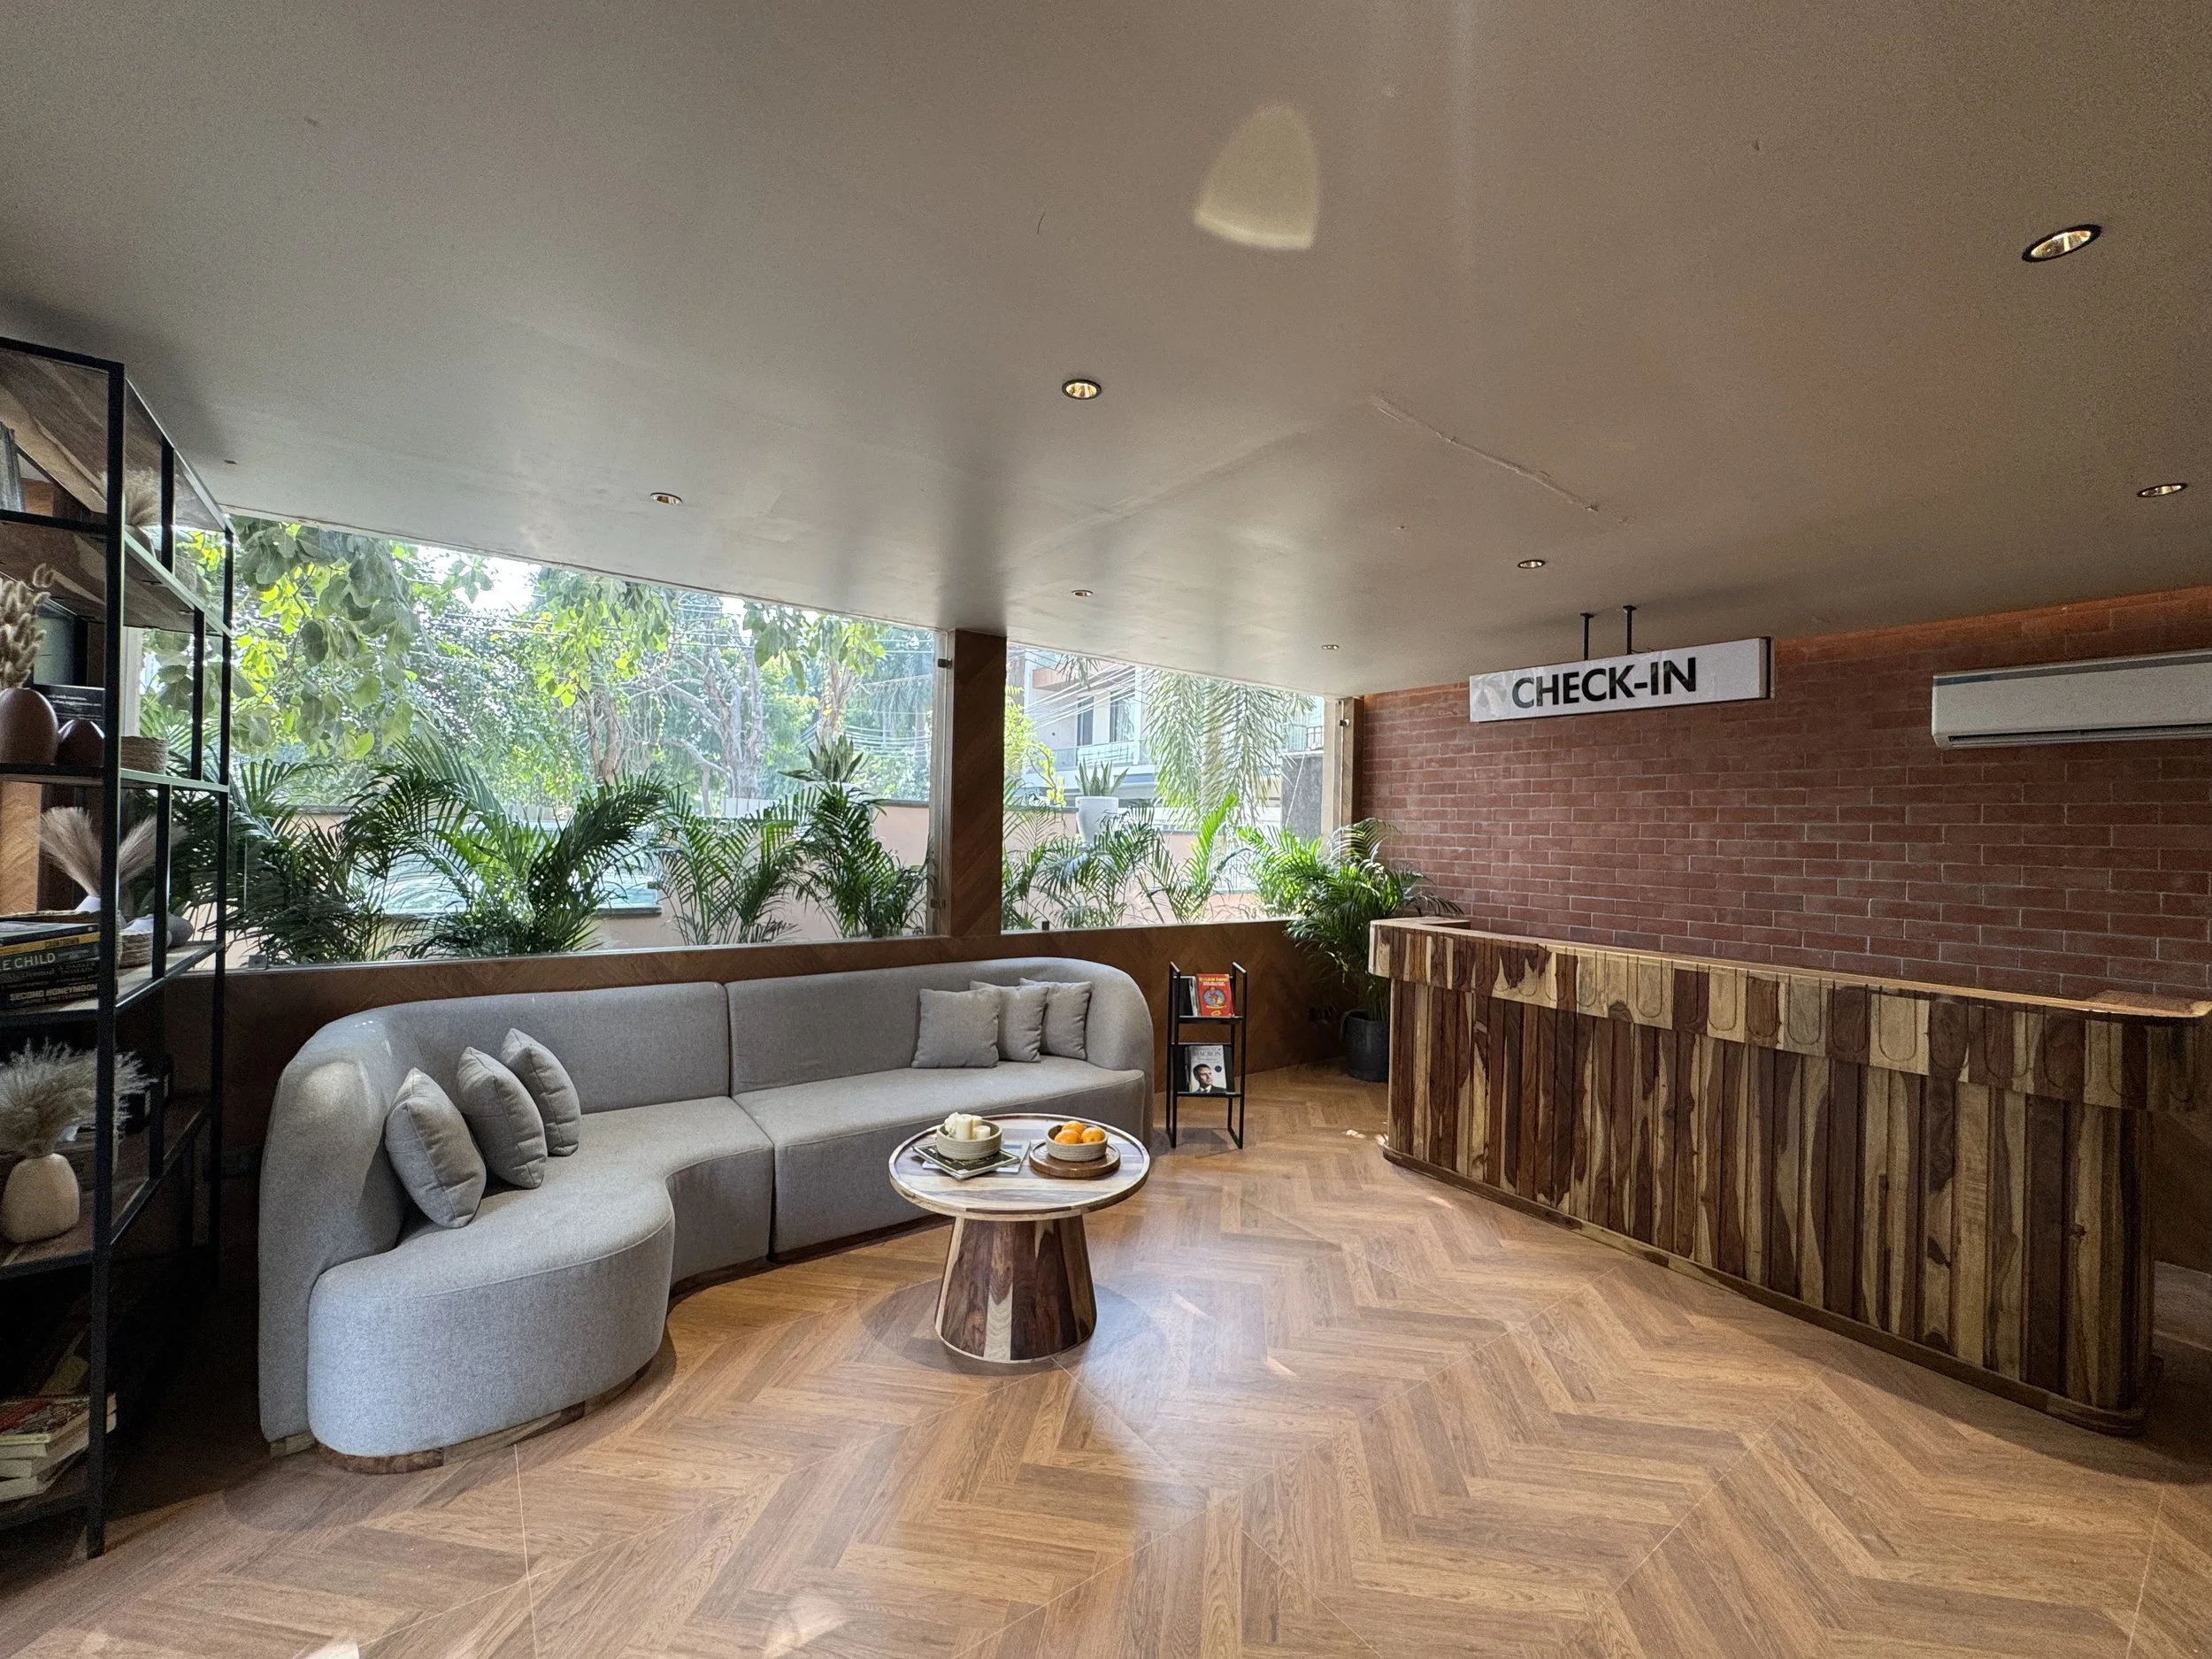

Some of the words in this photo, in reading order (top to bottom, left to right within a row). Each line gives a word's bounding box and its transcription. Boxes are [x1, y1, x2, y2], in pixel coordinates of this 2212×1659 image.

[1511, 657, 1697, 709] CHECK-IN
[14, 952, 57, 969] CHILD
[10, 989, 45, 1002] SECOND
[46, 982, 97, 997] HONEYMOON
